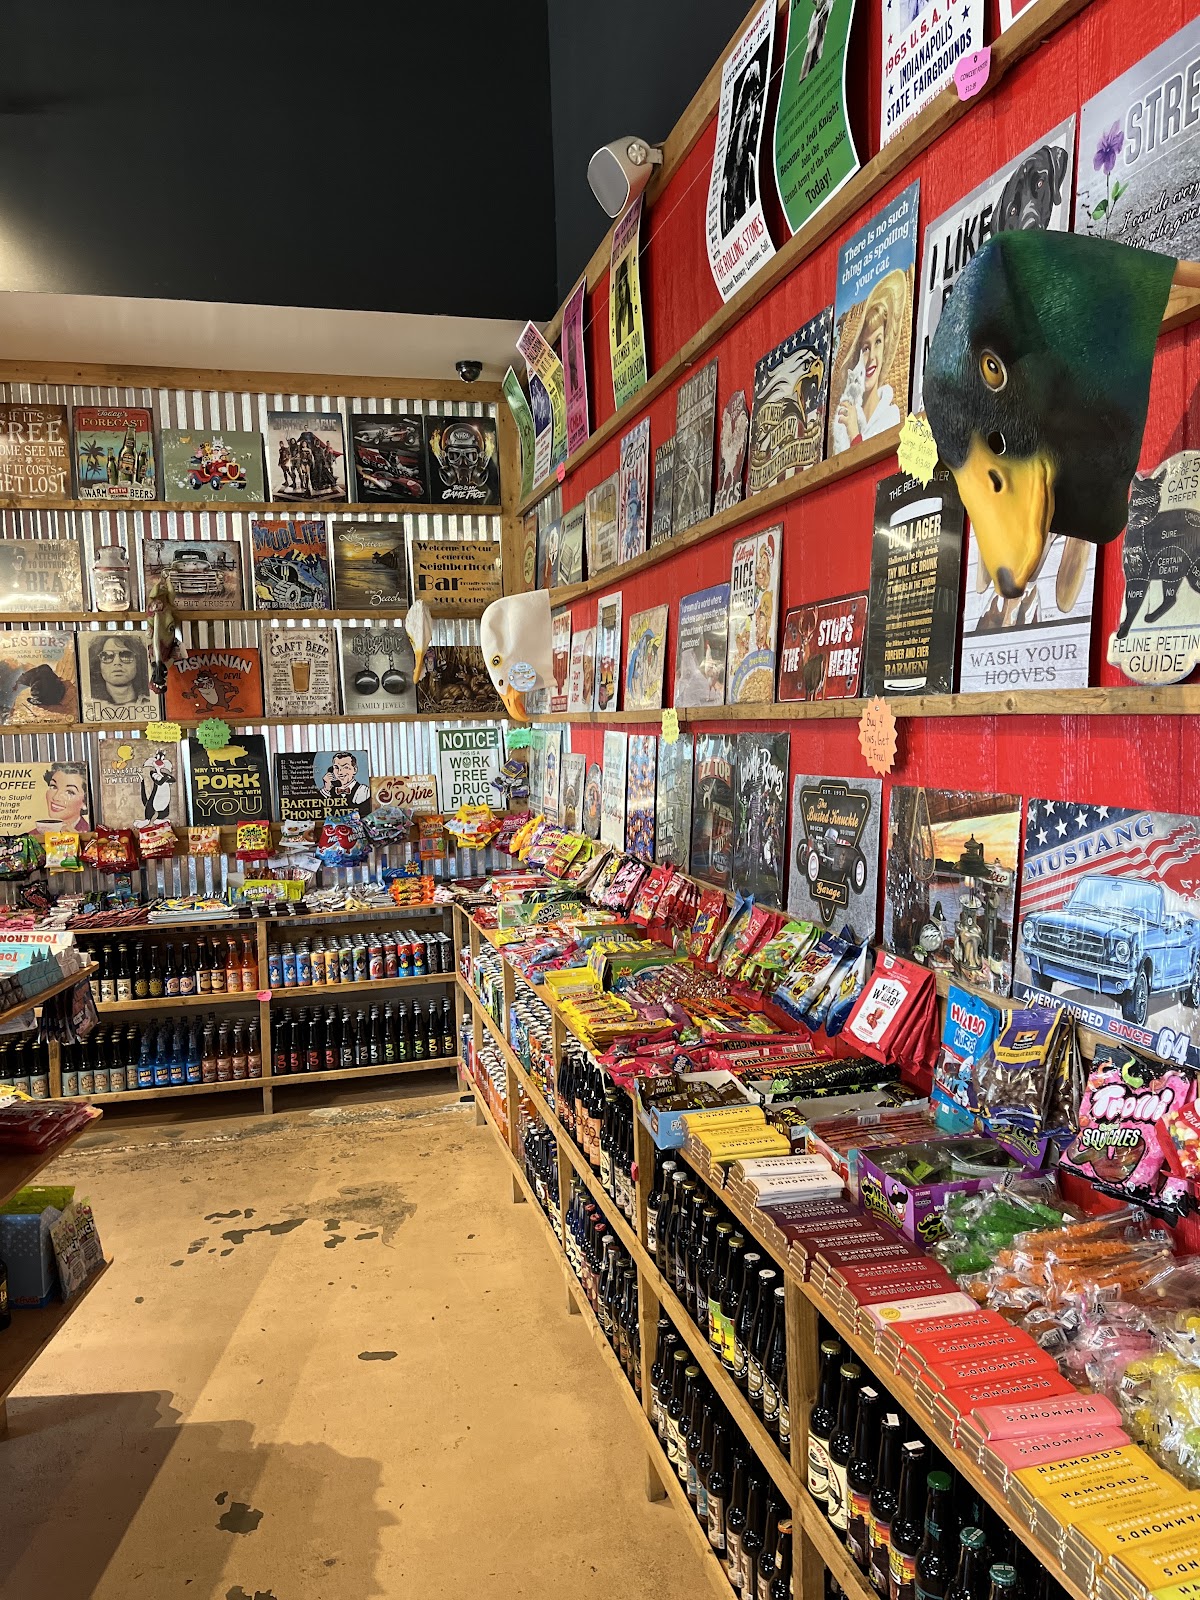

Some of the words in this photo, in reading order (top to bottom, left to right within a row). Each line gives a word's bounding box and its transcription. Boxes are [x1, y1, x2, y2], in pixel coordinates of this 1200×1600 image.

[885, 41, 907, 78] 1965
[900, 16, 953, 89] INDIANAPOLIS
[887, 87, 910, 126] STATE
[914, 27, 972, 99] FAIRGROUNDS
[960, 68, 977, 82] CONCERT
[1125, 57, 1200, 166] STRE
[780, 150, 800, 177] Become
[801, 143, 805, 151] a
[806, 126, 818, 148] Jedi
[819, 102, 839, 131] Knight
[801, 155, 811, 169] Join
[812, 143, 820, 156] the
[784, 185, 797, 205] Grand
[798, 171, 811, 190] Army
[811, 162, 816, 175] of
[816, 154, 824, 168] the
[824, 130, 846, 158] Republic
[805, 168, 832, 204] Today!
[844, 238, 864, 265] There
[864, 232, 875, 249] is
[876, 223, 888, 242] no
[888, 200, 909, 230] such
[714, 259, 726, 281] THE
[723, 237, 744, 273] ROLLING
[742, 213, 764, 251] STONES
[842, 261, 862, 285] thing
[863, 252, 874, 267] as
[874, 219, 910, 262] spoiling
[930, 241, 940, 292] I
[944, 205, 995, 279] LIKE
[854, 271, 873, 296] your
[874, 256, 890, 278] cat
[9, 412, 18, 421] IF
[24, 412, 44, 422] IT'S
[82, 418, 144, 427] FORECAST
[97, 409, 128, 418] Today's
[0, 445, 21, 456] OME
[25, 446, 45, 456] SEE
[49, 447, 65, 457] ME
[3, 465, 11, 473] IF
[14, 465, 23, 474] IT
[26, 465, 56, 475] COSTS
[1192, 458, 1200, 472] 5
[29, 471, 67, 493] LOST
[889, 485, 902, 501] THE
[904, 479, 920, 492] BEER
[1168, 475, 1198, 493] CATS
[84, 488, 107, 498] WARM
[130, 489, 154, 499] BEERS
[442, 490, 466, 499] GAME
[466, 490, 486, 499] FACE
[714, 483, 742, 516] EGGS
[1168, 491, 1196, 504] PREFER
[652, 512, 670, 536] EGGS
[889, 525, 907, 550] OUR
[910, 513, 941, 544] LAGER
[1161, 530, 1177, 540] SURE
[417, 542, 459, 551] Welcome
[1158, 557, 1182, 566] CERTAIN
[1159, 565, 1178, 575] DEATH
[419, 575, 463, 590] Bar
[734, 561, 754, 591] RICE
[370, 589, 402, 606] Beach
[1128, 590, 1143, 598] NOPE
[817, 615, 855, 646] STOPS
[270, 641, 303, 657] CRAFT
[306, 640, 329, 659] BEER
[1113, 637, 1150, 653] FELINE
[1156, 634, 1200, 652] PETTIN
[783, 648, 800, 672] THE
[828, 647, 859, 678] HERE
[885, 648, 904, 661] FOREVER
[905, 647, 915, 659] AND
[917, 646, 929, 657] EVER
[971, 649, 1019, 668] WASH
[1026, 644, 1078, 663] YOUR
[174, 654, 252, 674] TASMANIAN
[885, 660, 928, 677] BARMEN!
[1128, 654, 1186, 673] GUIDE
[985, 667, 1057, 685] HOOVES
[866, 712, 876, 732] Buy
[879, 715, 884, 726] 4
[443, 732, 495, 749] NOTICE
[454, 769, 487, 781] FREE
[700, 760, 710, 778] ZZ
[713, 758, 730, 782] TOP
[0, 781, 36, 790] OFFEE
[195, 774, 260, 790] PORK
[453, 782, 490, 795] DRUG
[281, 798, 348, 809] BARTENDER
[395, 787, 434, 806] Wine
[817, 798, 827, 809] The
[197, 797, 263, 816] YOU
[282, 808, 322, 820] PHONE
[807, 806, 830, 822] Busted
[829, 809, 859, 828] Knuckle
[1024, 815, 1154, 880] MUSTANG
[243, 887, 258, 896] Fun
[259, 886, 272, 894] Dip
[816, 882, 841, 898] Garage
[0, 933, 57, 943] TOBLERON
[1108, 1020, 1153, 1046] SINCE
[1156, 1027, 1189, 1064] 64
[735, 1052, 789, 1066] CHARLESTON
[1091, 1085, 1173, 1121] Trolli
[916, 1317, 989, 1333] HAMMOND'S
[938, 1337, 1015, 1353] HAMMOND'S
[958, 1358, 1037, 1378] HAMMOND'S
[970, 1380, 1050, 1400] HAMMOND'S
[1006, 1406, 1096, 1422] HAMMOND'S
[1037, 1450, 1122, 1474] HAMMOND'S
[1044, 1468, 1086, 1483] BANANA
[1089, 1457, 1131, 1470] CRUNCH
[1060, 1475, 1149, 1498] HAMMOND'S
[1068, 1492, 1112, 1506] BANANA
[1115, 1482, 1159, 1495] CRUNCH
